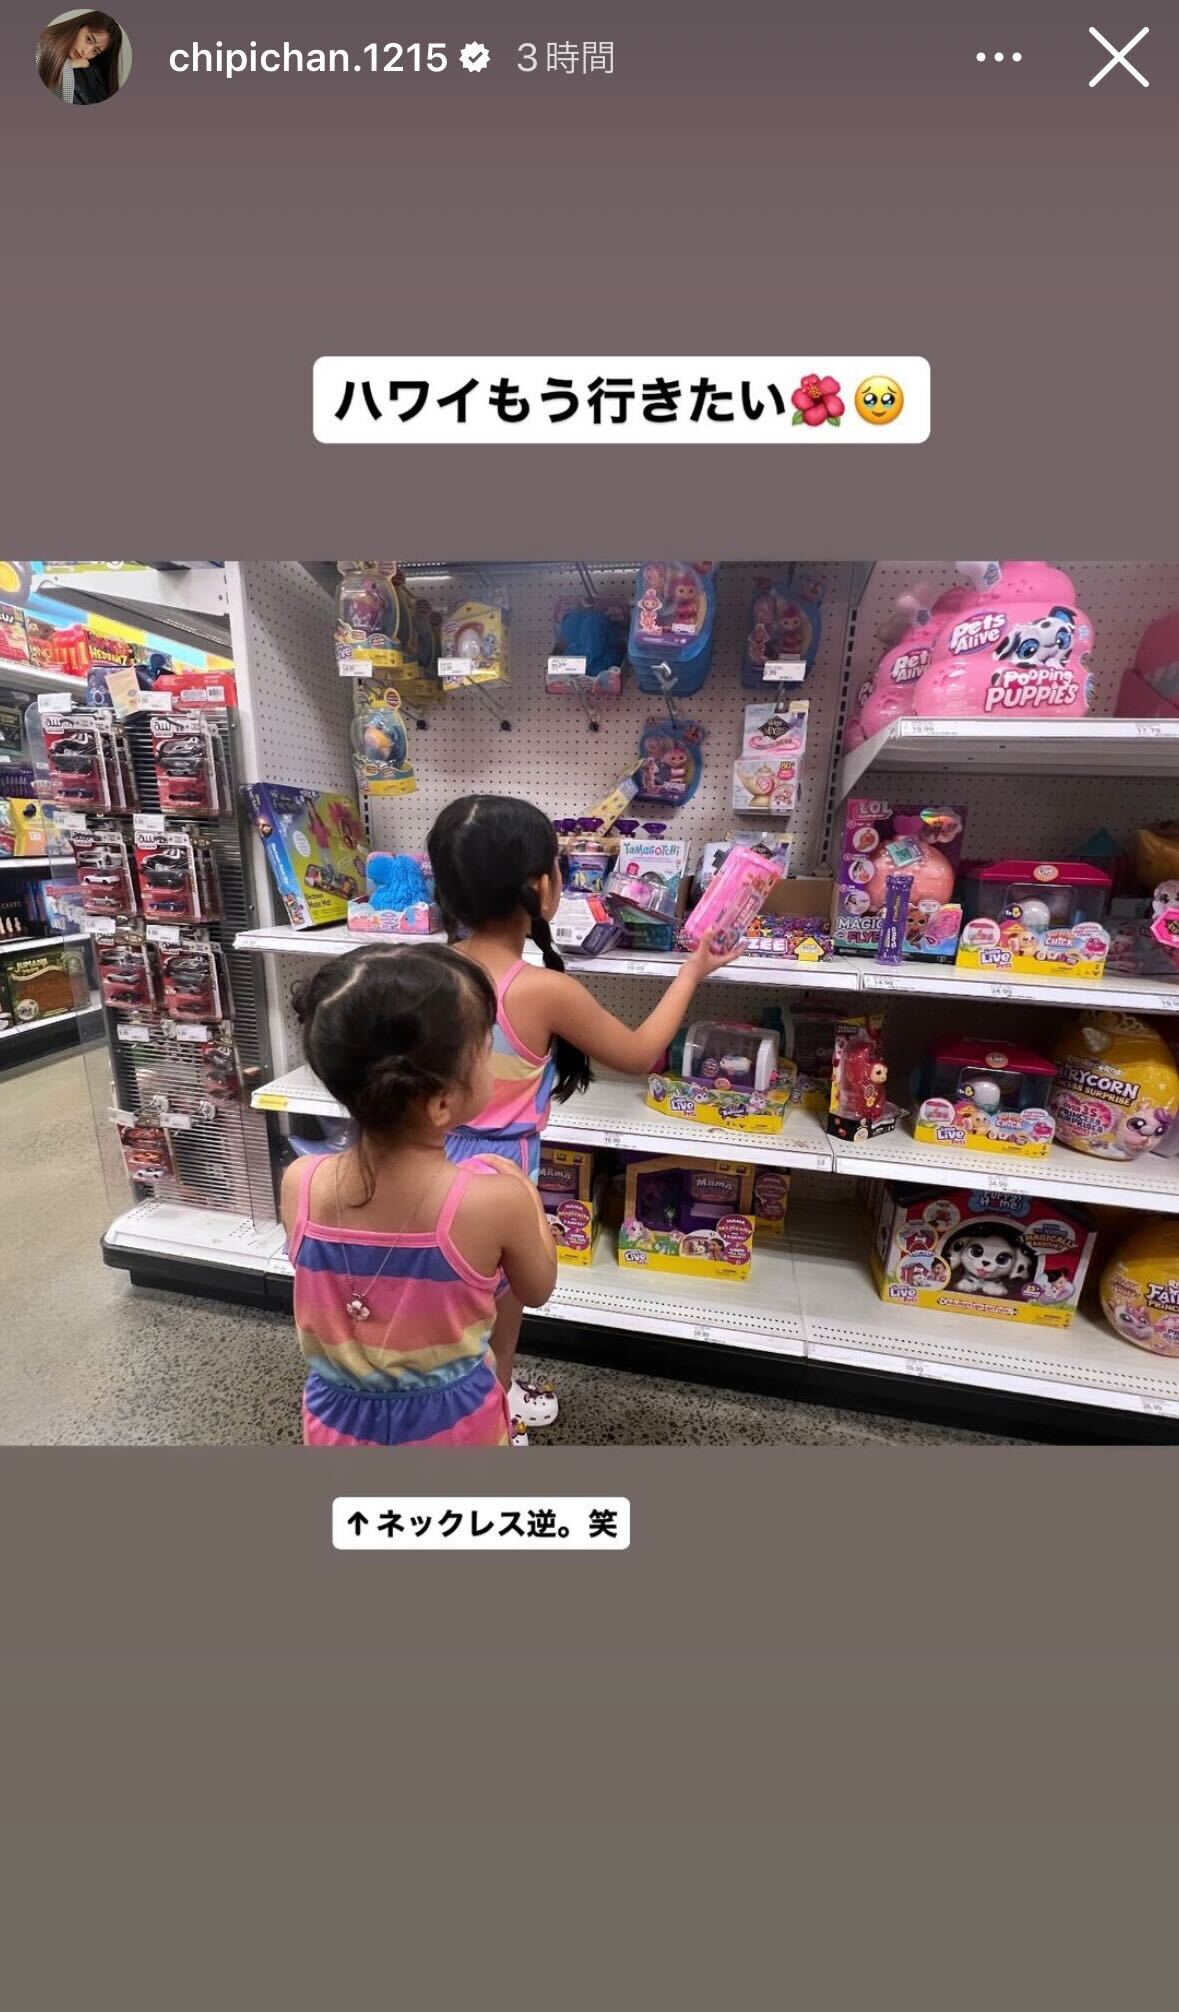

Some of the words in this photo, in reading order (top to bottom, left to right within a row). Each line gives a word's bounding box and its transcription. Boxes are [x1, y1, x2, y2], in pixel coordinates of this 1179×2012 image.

[954, 629, 1000, 654] Alive
[981, 951, 1011, 965] Live
[671, 1099, 695, 1112] Live
[936, 1128, 966, 1141] Live
[889, 1287, 917, 1298] Live
